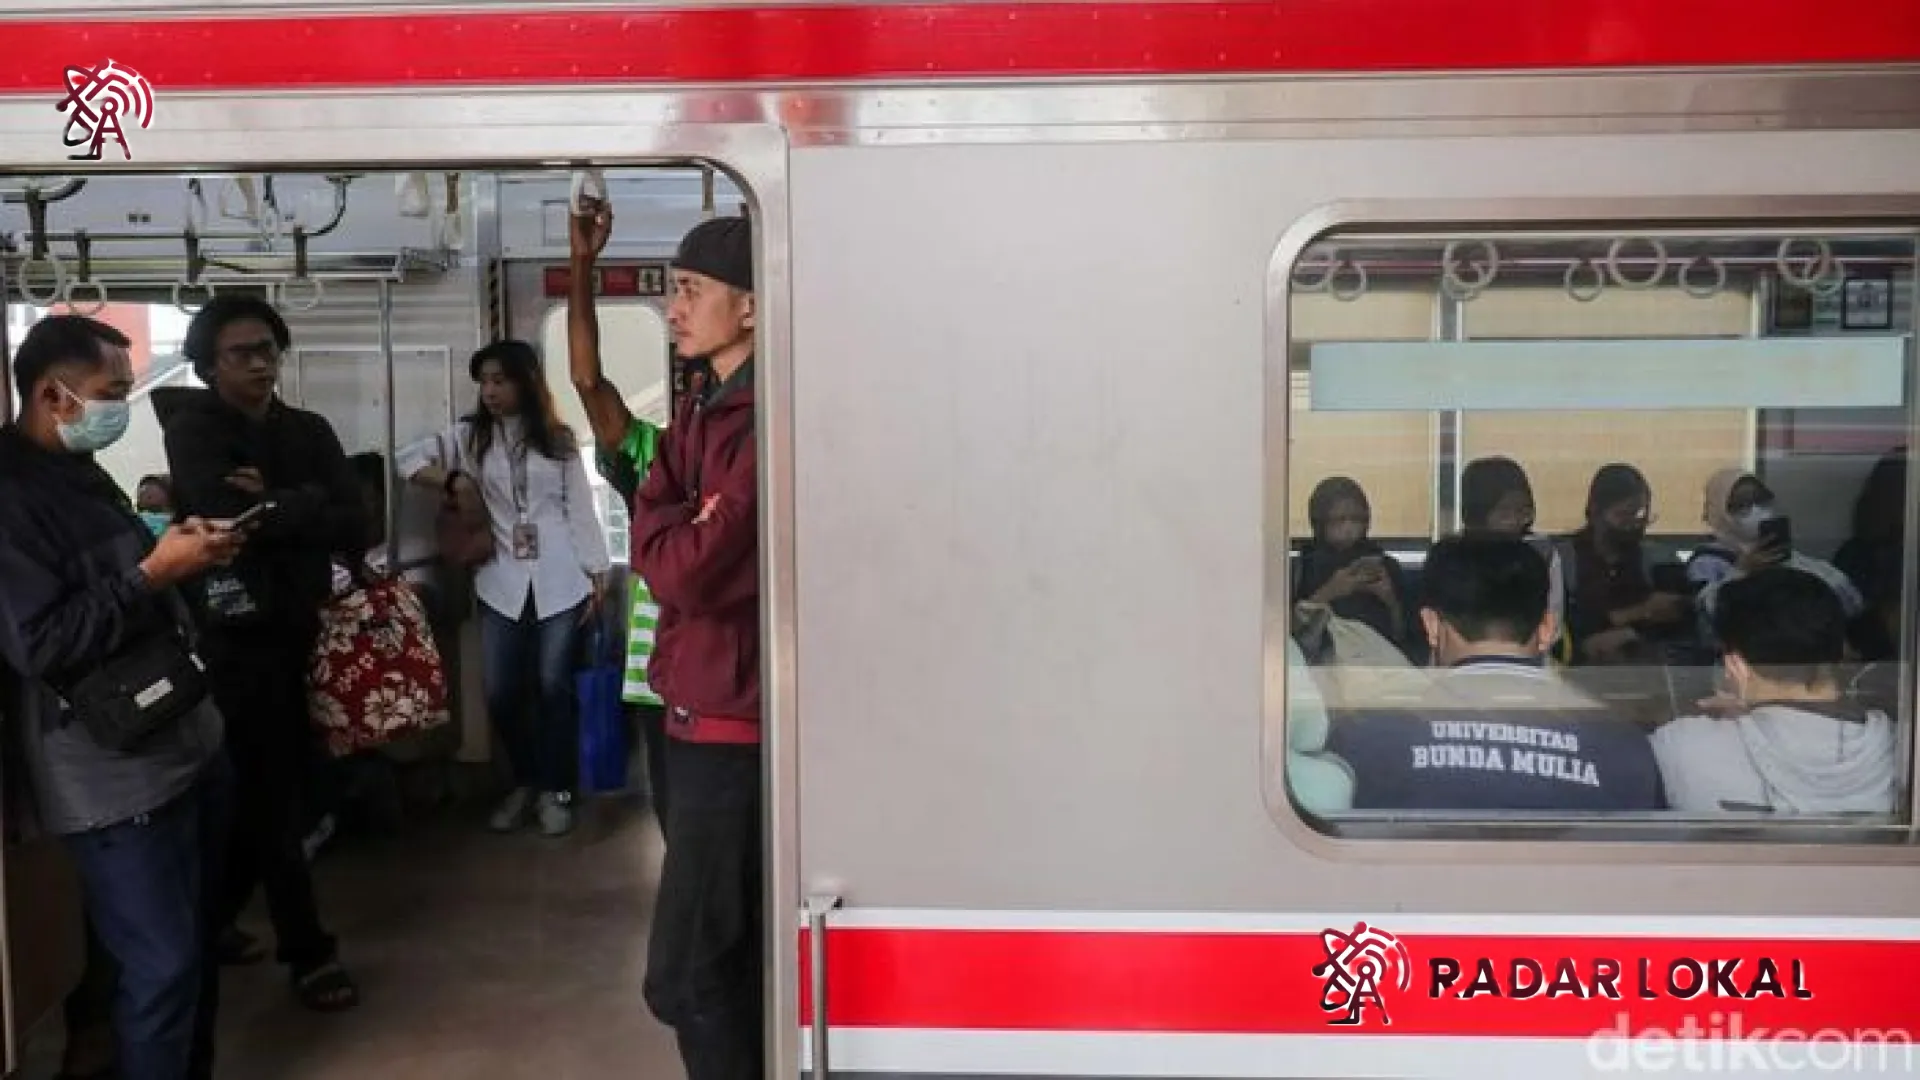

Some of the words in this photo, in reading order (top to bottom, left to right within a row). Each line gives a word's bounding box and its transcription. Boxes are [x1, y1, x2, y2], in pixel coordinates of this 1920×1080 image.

[1431, 720, 1579, 752] UNIVERSITAS
[1411, 745, 1504, 770] BUNDA
[1513, 749, 1600, 787] MULIA
